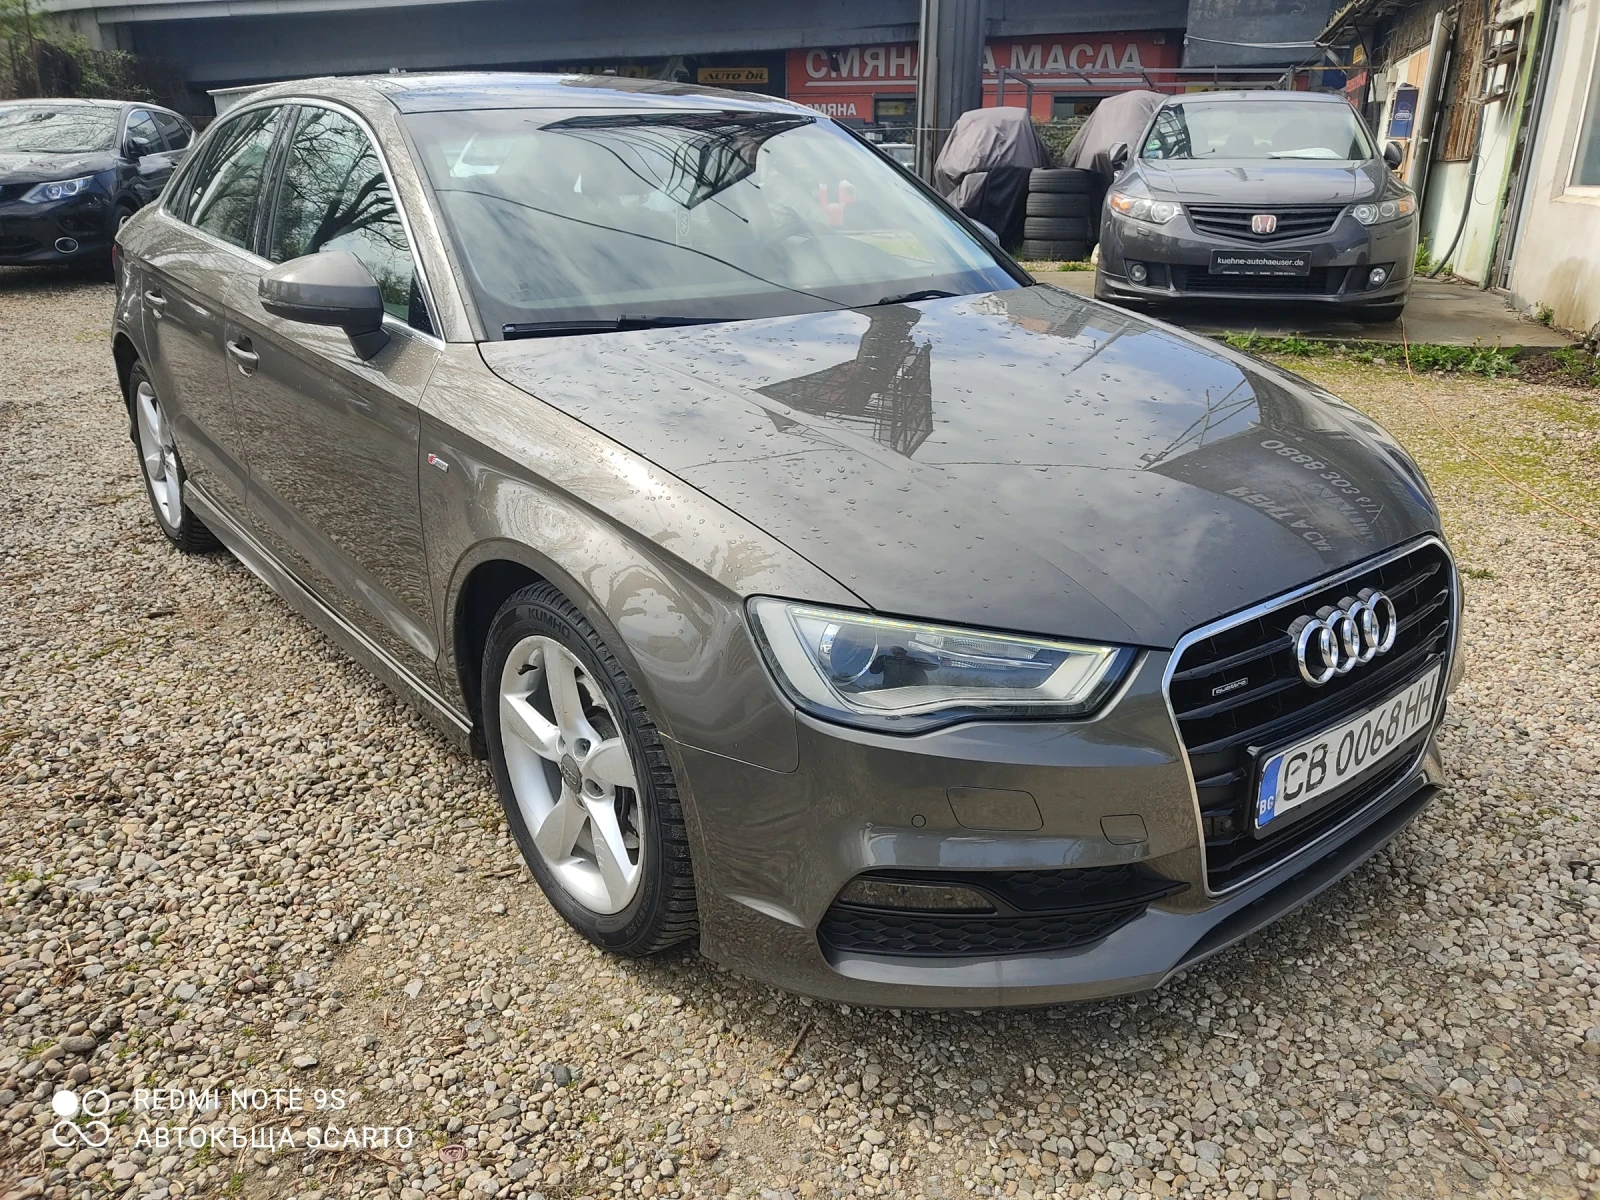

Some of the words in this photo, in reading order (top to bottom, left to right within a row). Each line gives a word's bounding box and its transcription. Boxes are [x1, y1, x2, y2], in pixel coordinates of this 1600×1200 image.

[805, 47, 918, 78] СМЯН
[1010, 43, 1143, 75] МАСЛА
[703, 72, 741, 80] AUTO
[1217, 256, 1304, 267] kuehne-autohaeuser.de
[528, 607, 571, 641] KUMHO
[1336, 700, 1402, 777] 0068
[1259, 795, 1275, 814] BG
